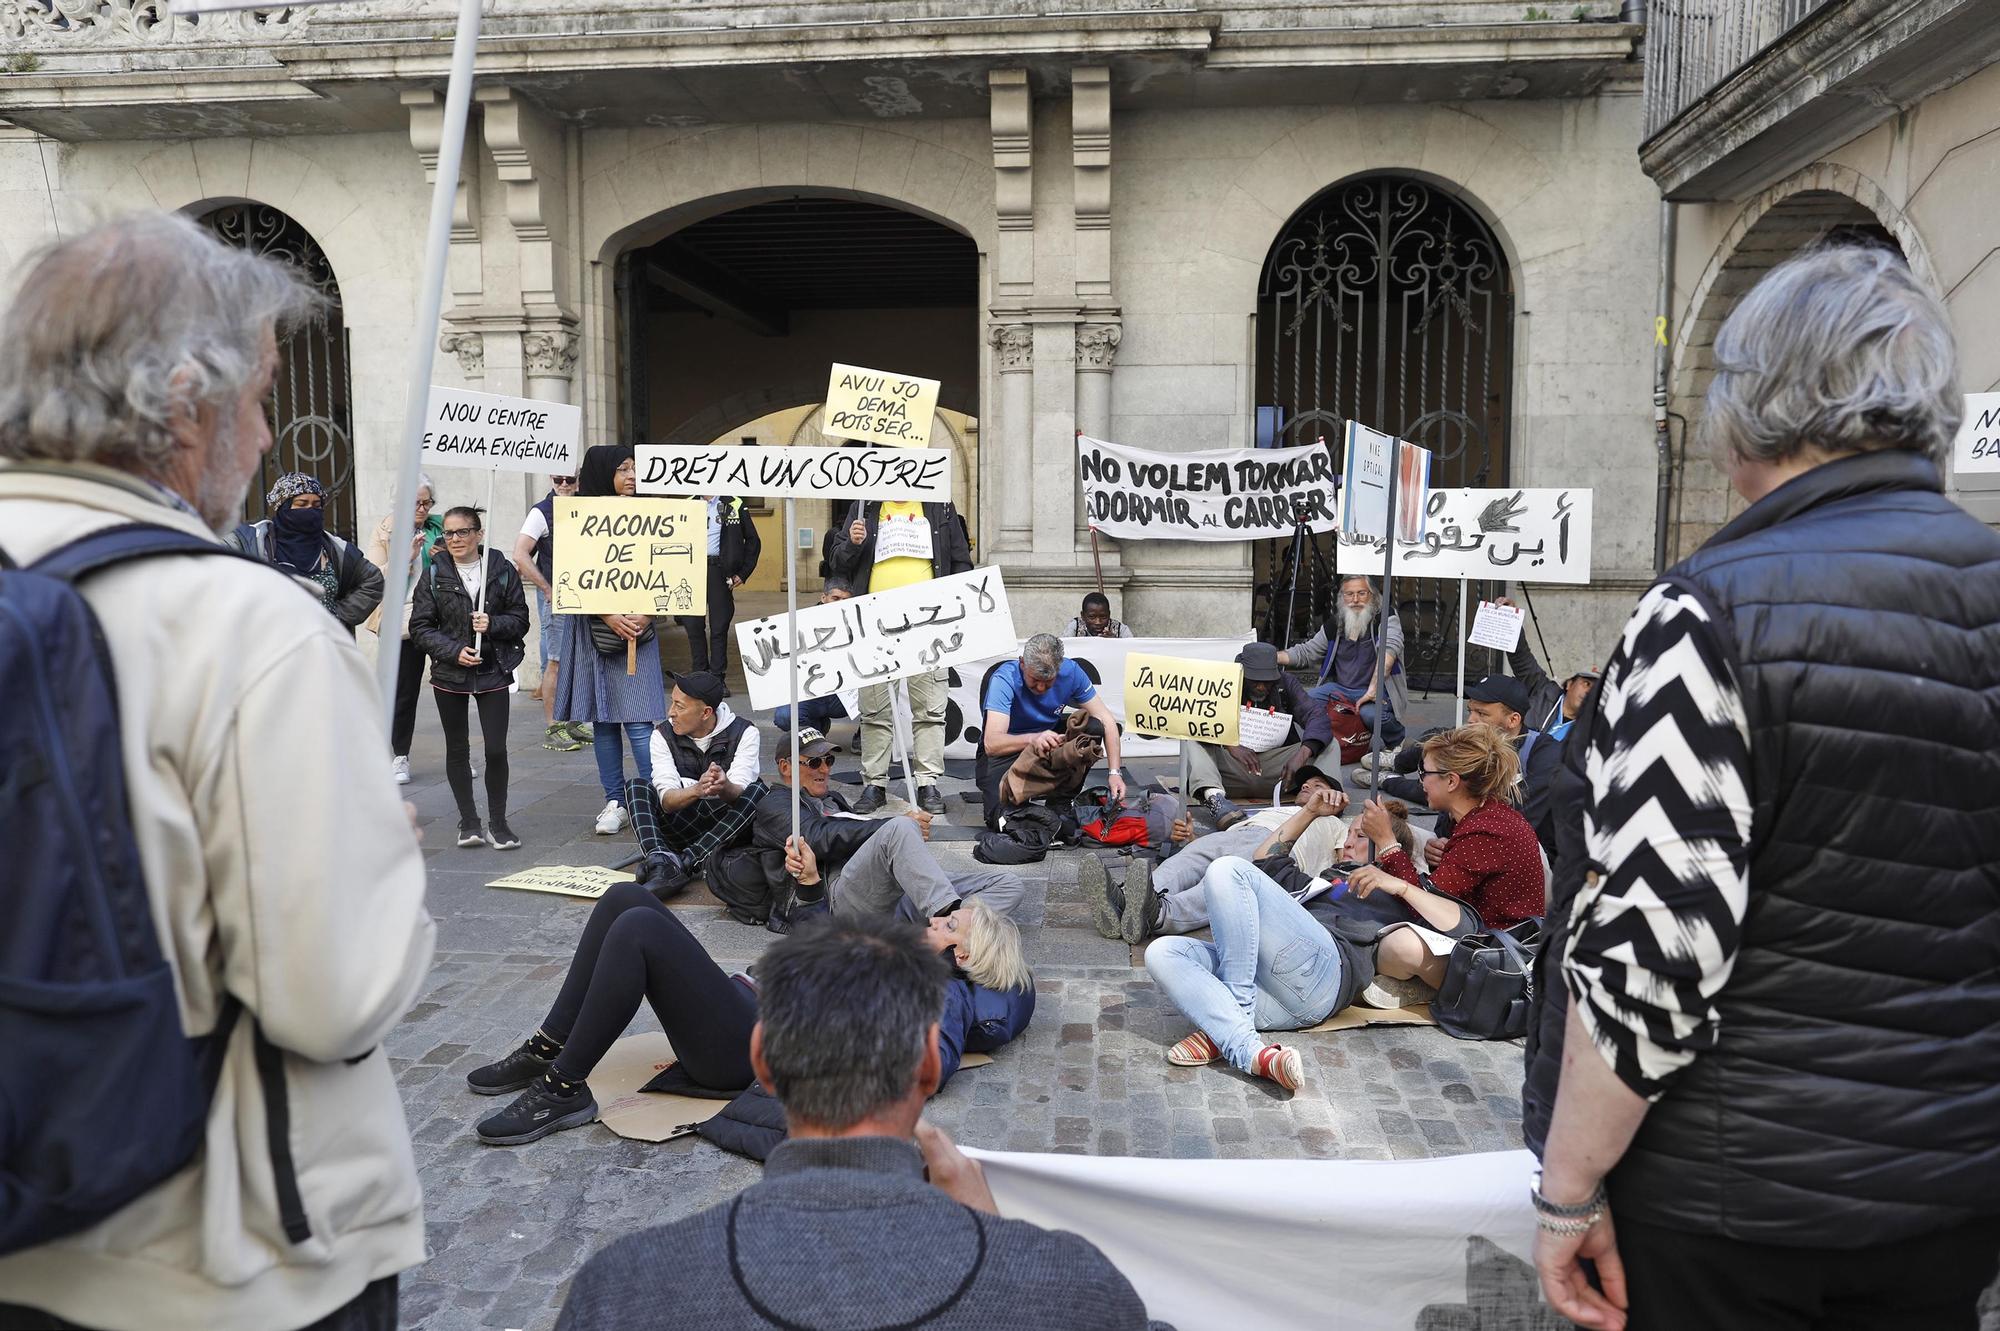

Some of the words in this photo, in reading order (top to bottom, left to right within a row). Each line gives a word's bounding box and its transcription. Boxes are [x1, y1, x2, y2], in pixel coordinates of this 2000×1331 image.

[839, 374, 885, 392] AVUI
[892, 380, 920, 398] JO
[439, 402, 482, 422] NOU
[488, 408, 549, 430] CENTRE
[857, 397, 908, 420] DEMÀ
[831, 411, 873, 432] POTS
[873, 417, 924, 441] SER...
[436, 434, 487, 456] BAIXA
[490, 434, 570, 462] EXIGÈNCIA
[641, 451, 728, 487] DRET
[727, 458, 750, 487] A
[760, 455, 814, 488] UN
[810, 450, 947, 490] SOSTRE
[1081, 449, 1121, 484] NO
[1128, 461, 1232, 496] VOLEM
[1234, 452, 1334, 494] TORNAR
[1202, 514, 1223, 528] AL
[1224, 488, 1335, 529] CARRER
[605, 543, 636, 563] DE
[578, 567, 669, 592] GIRONA
[966, 575, 995, 613] لا
[877, 595, 967, 642] نحب
[742, 603, 866, 677] العيش
[919, 626, 964, 671] في
[1133, 666, 1154, 688] JA
[1159, 673, 1194, 694] VAN
[1197, 678, 1233, 698] UNS
[1149, 694, 1218, 718] QUANTS
[1135, 714, 1169, 731] R.I.P.
[1188, 721, 1224, 738] D.E.P
